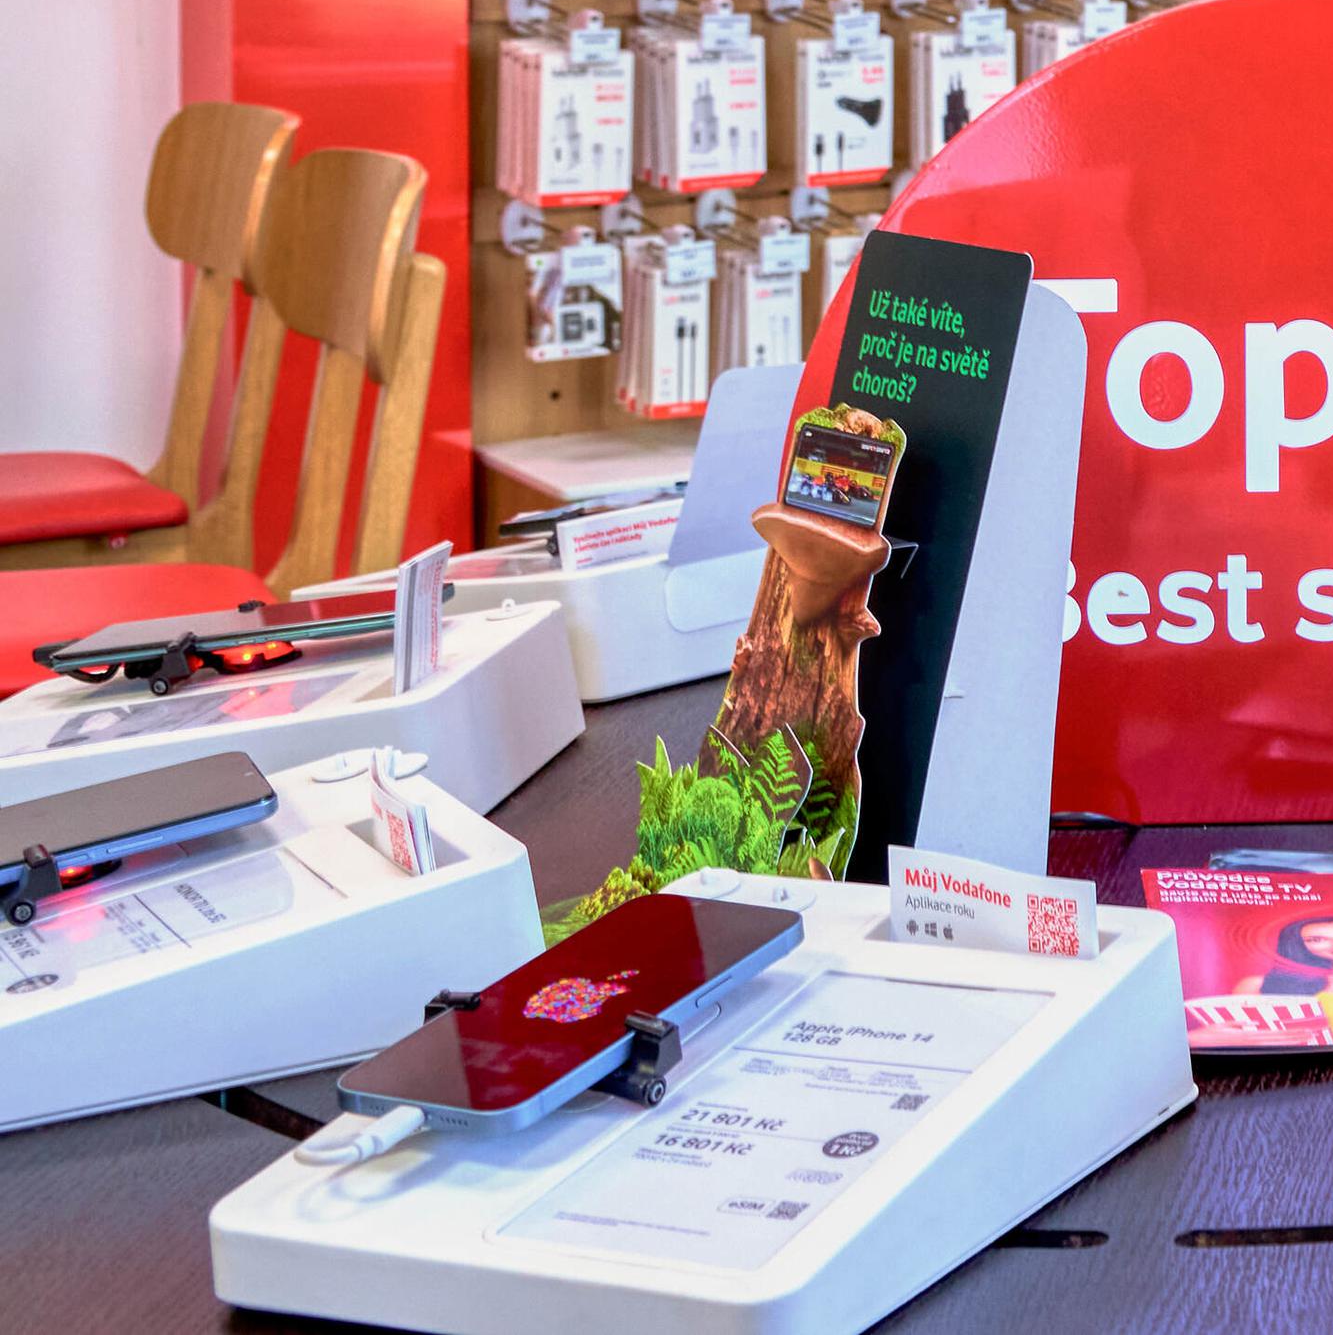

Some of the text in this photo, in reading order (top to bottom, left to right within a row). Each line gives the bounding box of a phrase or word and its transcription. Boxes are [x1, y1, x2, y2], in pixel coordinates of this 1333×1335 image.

[869, 290, 966, 339] Už také víte,
[859, 331, 991, 380] proč je na světě
[852, 365, 917, 403] choroš?
[904, 867, 1012, 909] Můj Vodafone
[1156, 870, 1271, 884] Průvodce
[1157, 879, 1313, 894] Vodafone TV
[905, 894, 975, 919] Aplikace roku
[781, 1032, 842, 1046] 128 GB
[791, 1020, 935, 1044] Apple iPhone 14
[681, 1108, 711, 1122] 21
[711, 1112, 754, 1128] 801
[754, 1117, 788, 1132] Kč
[654, 1133, 756, 1156] 16 801 Kč
[828, 1143, 865, 1157] 1 Kč
